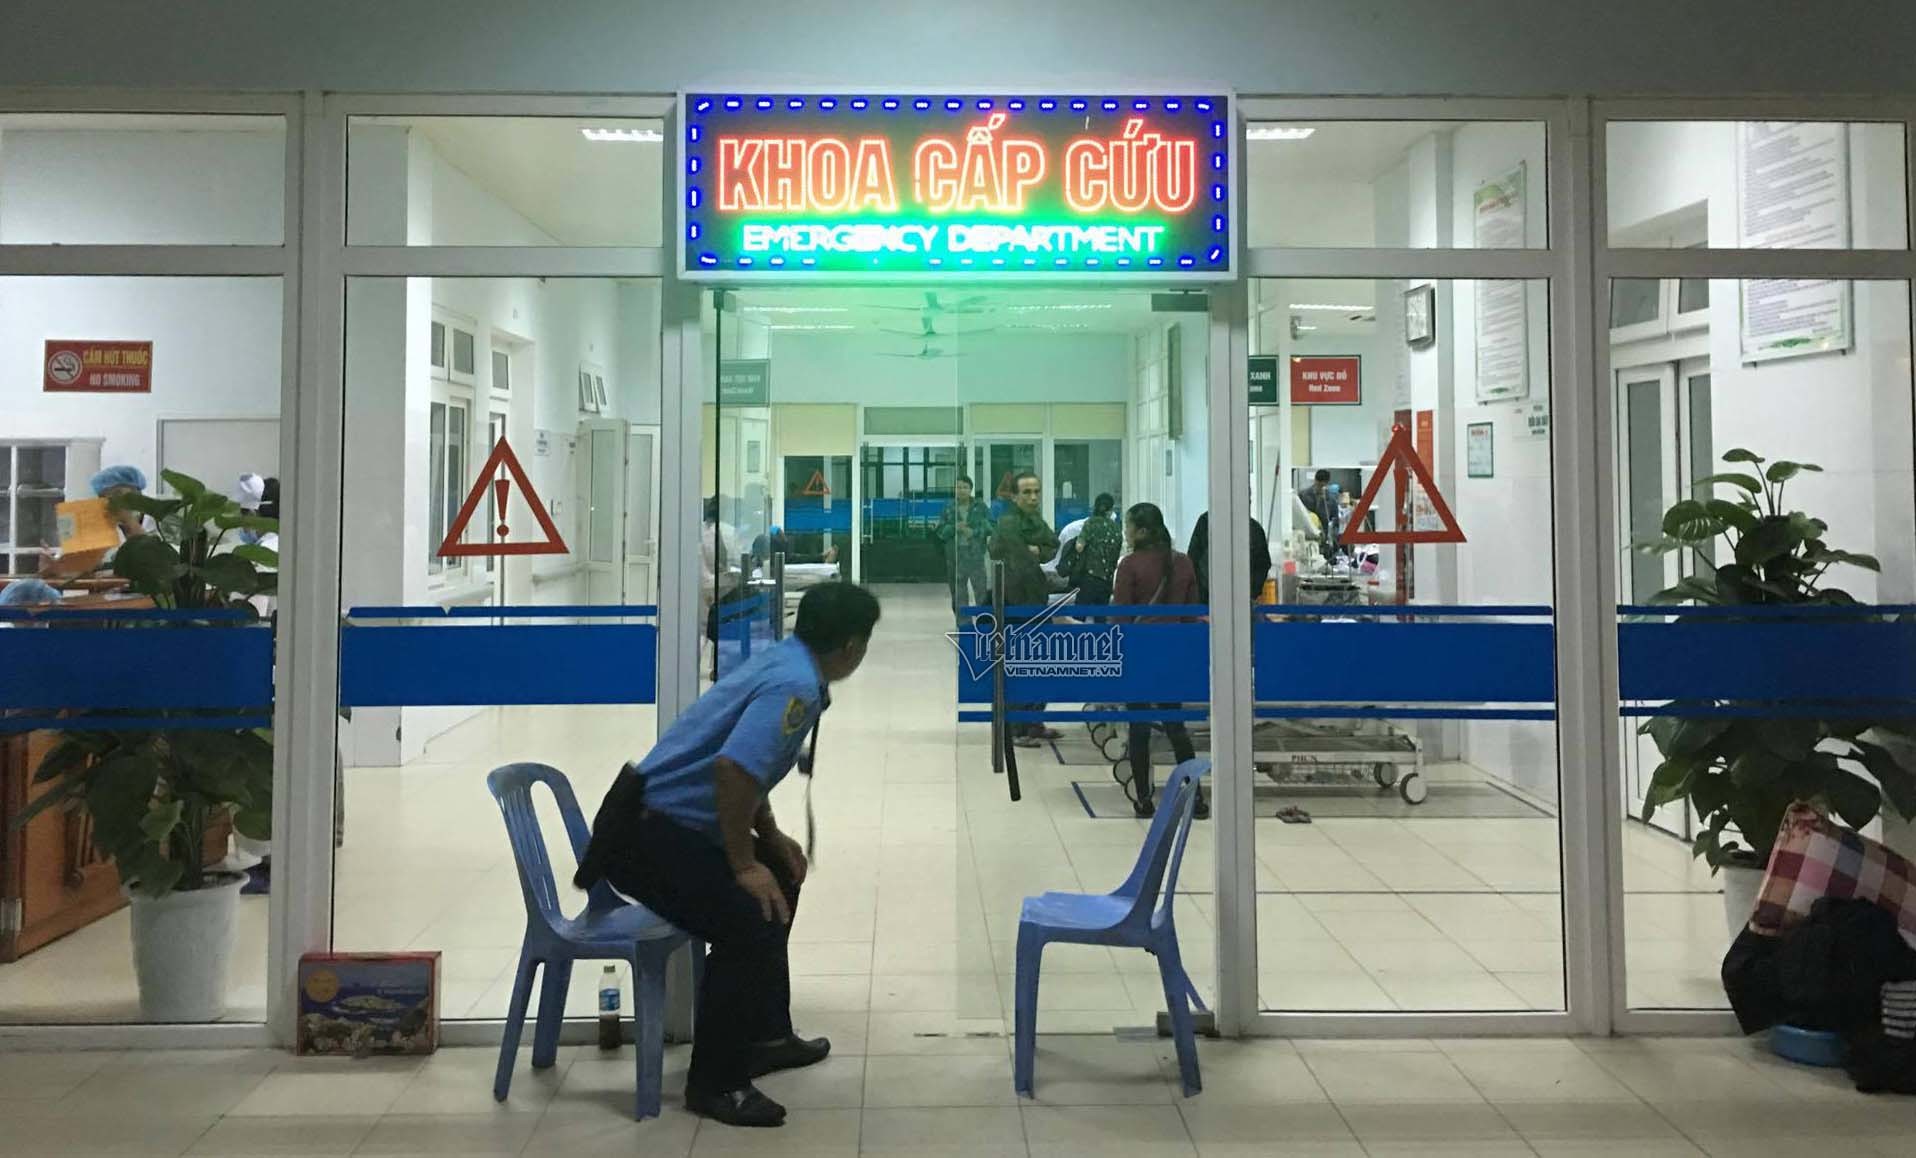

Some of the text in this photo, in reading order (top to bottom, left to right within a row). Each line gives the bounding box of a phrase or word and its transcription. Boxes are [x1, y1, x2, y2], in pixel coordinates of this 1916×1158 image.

[719, 113, 1195, 212] KHOA CẤP CỨU
[742, 225, 1164, 252] EMERGENCY DEPARTMENT
[89, 373, 140, 386] NO SMOKING
[1250, 371, 1271, 381] XANH
[1302, 371, 1318, 381] KHU
[1319, 371, 1334, 383] VỰC
[1309, 384, 1341, 393] Red Zone
